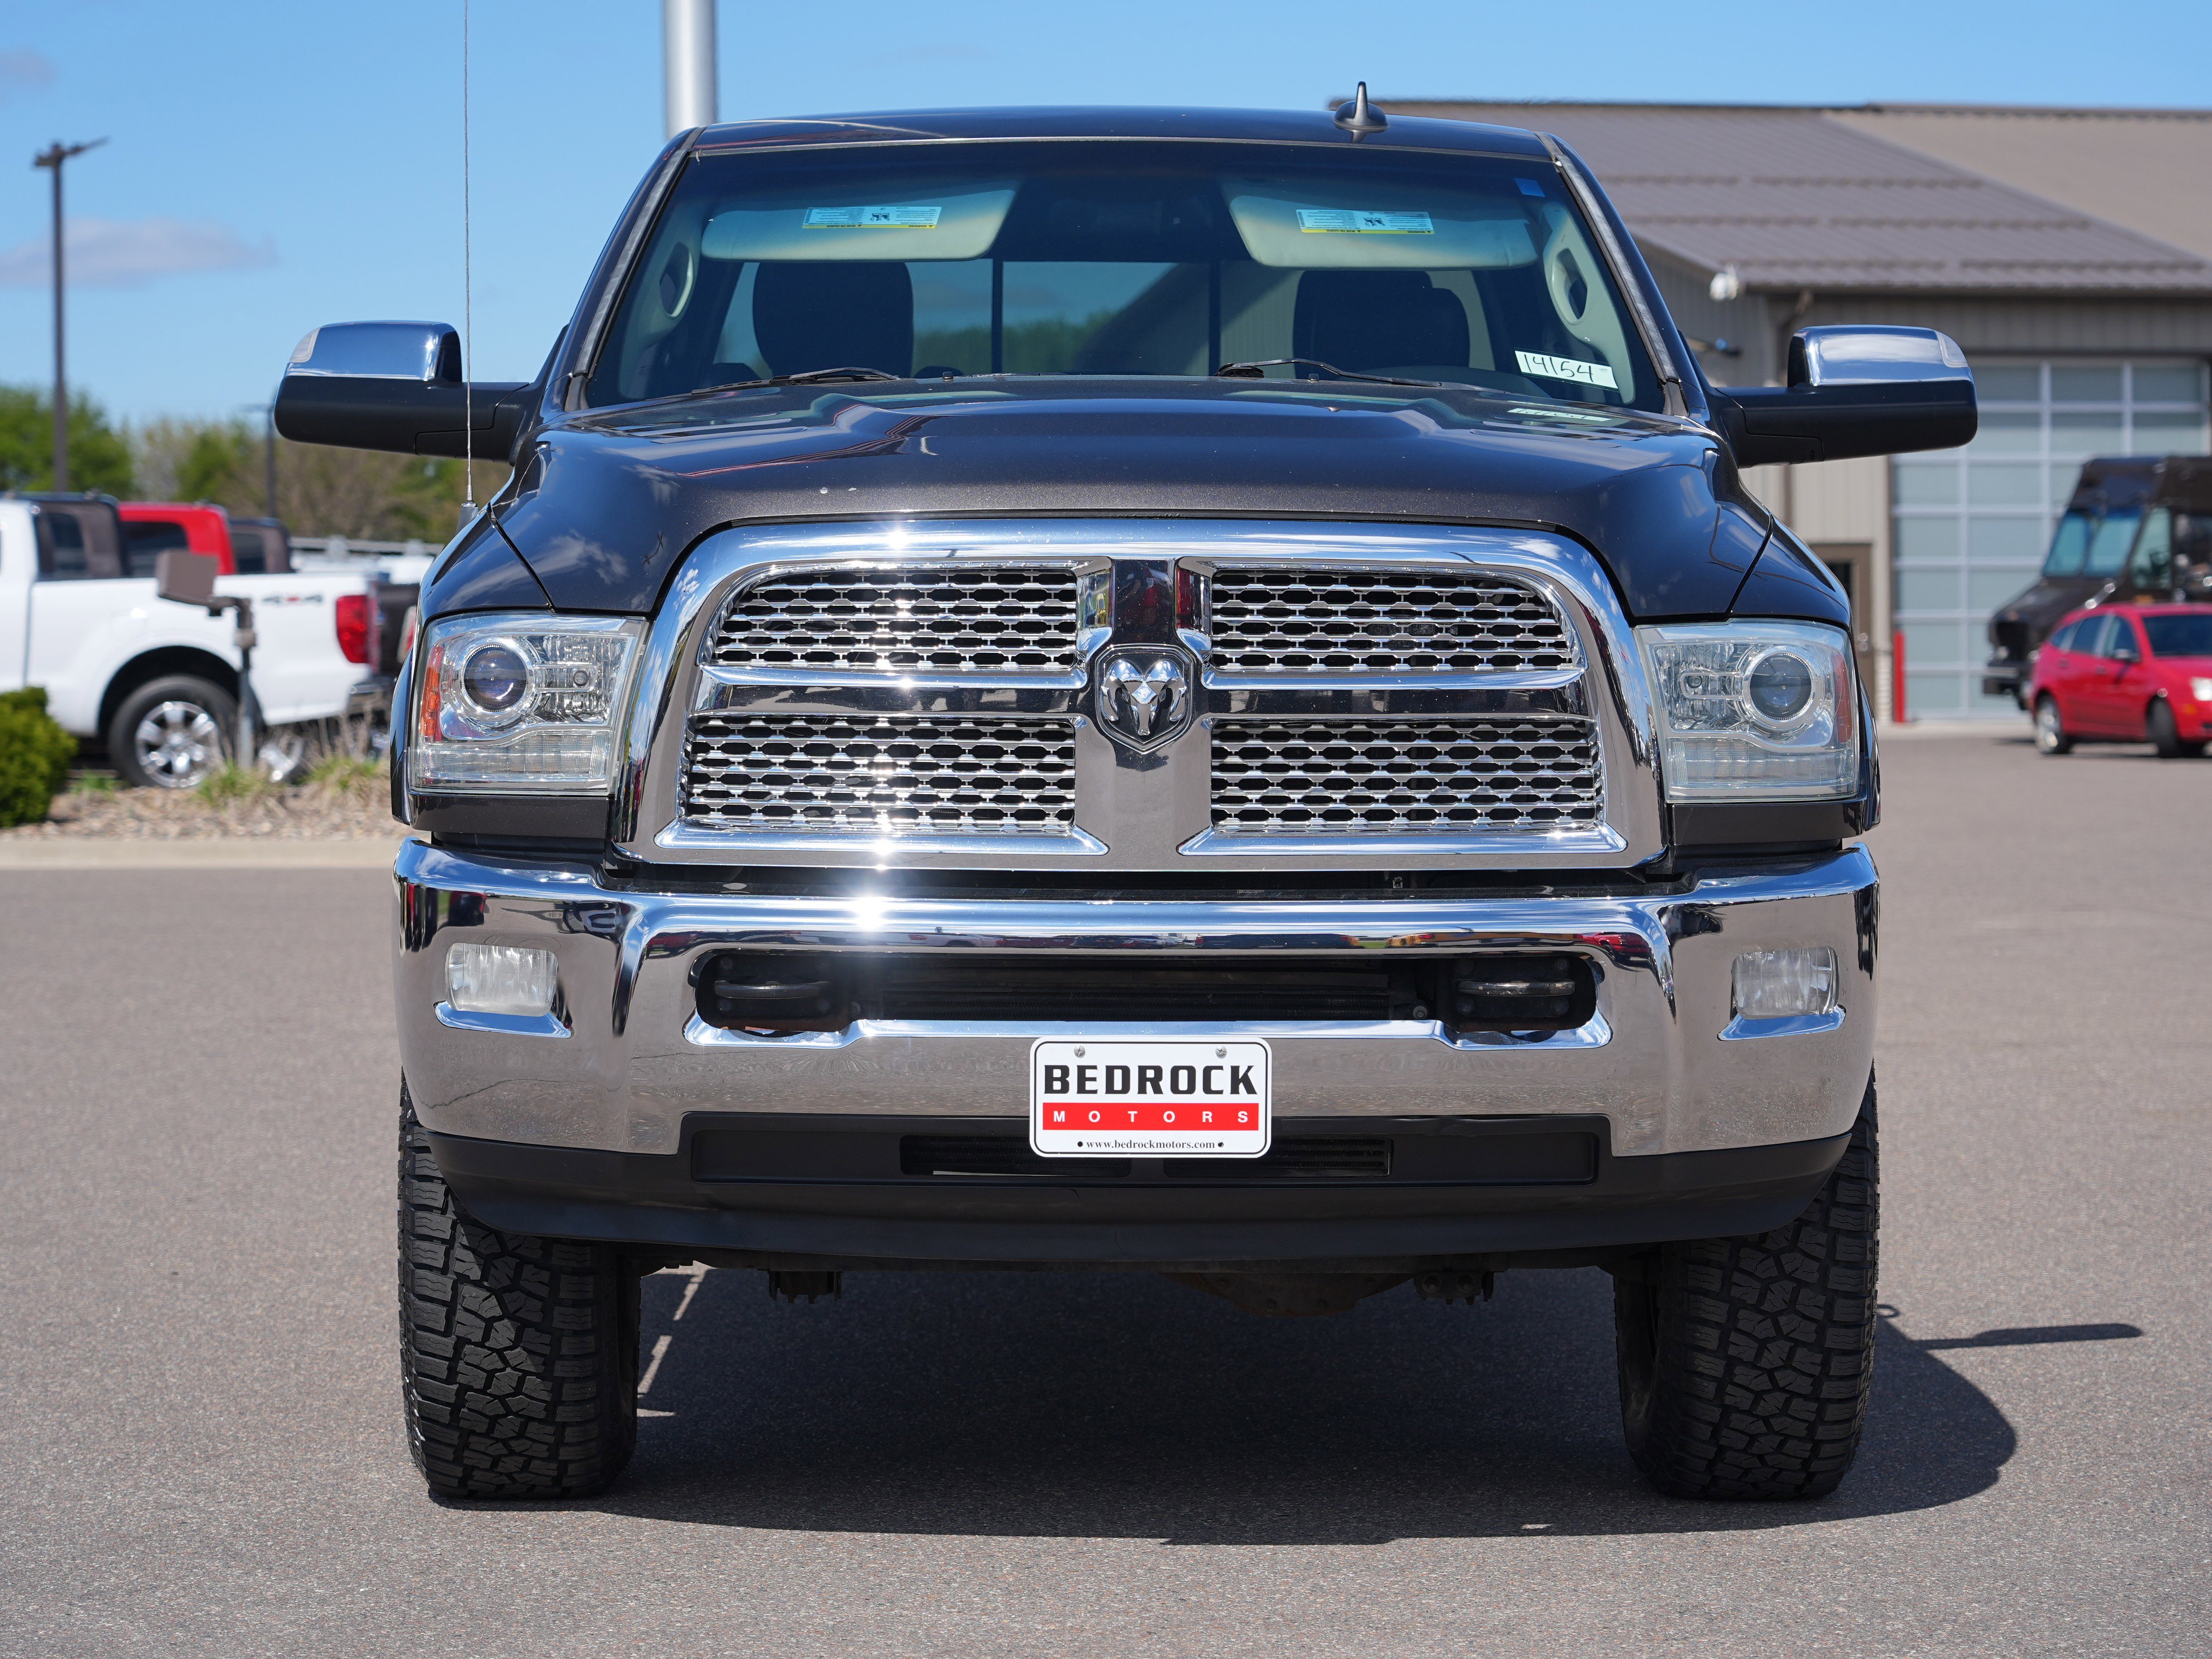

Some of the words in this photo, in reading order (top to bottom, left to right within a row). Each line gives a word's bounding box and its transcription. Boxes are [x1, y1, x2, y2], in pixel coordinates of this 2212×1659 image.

[1524, 354, 1594, 382] 14154
[1044, 1065, 1257, 1094] BEDROCK
[1054, 1111, 1248, 1123] MOTORS
[1087, 1140, 1215, 1149] www.bedrockmotors.com
